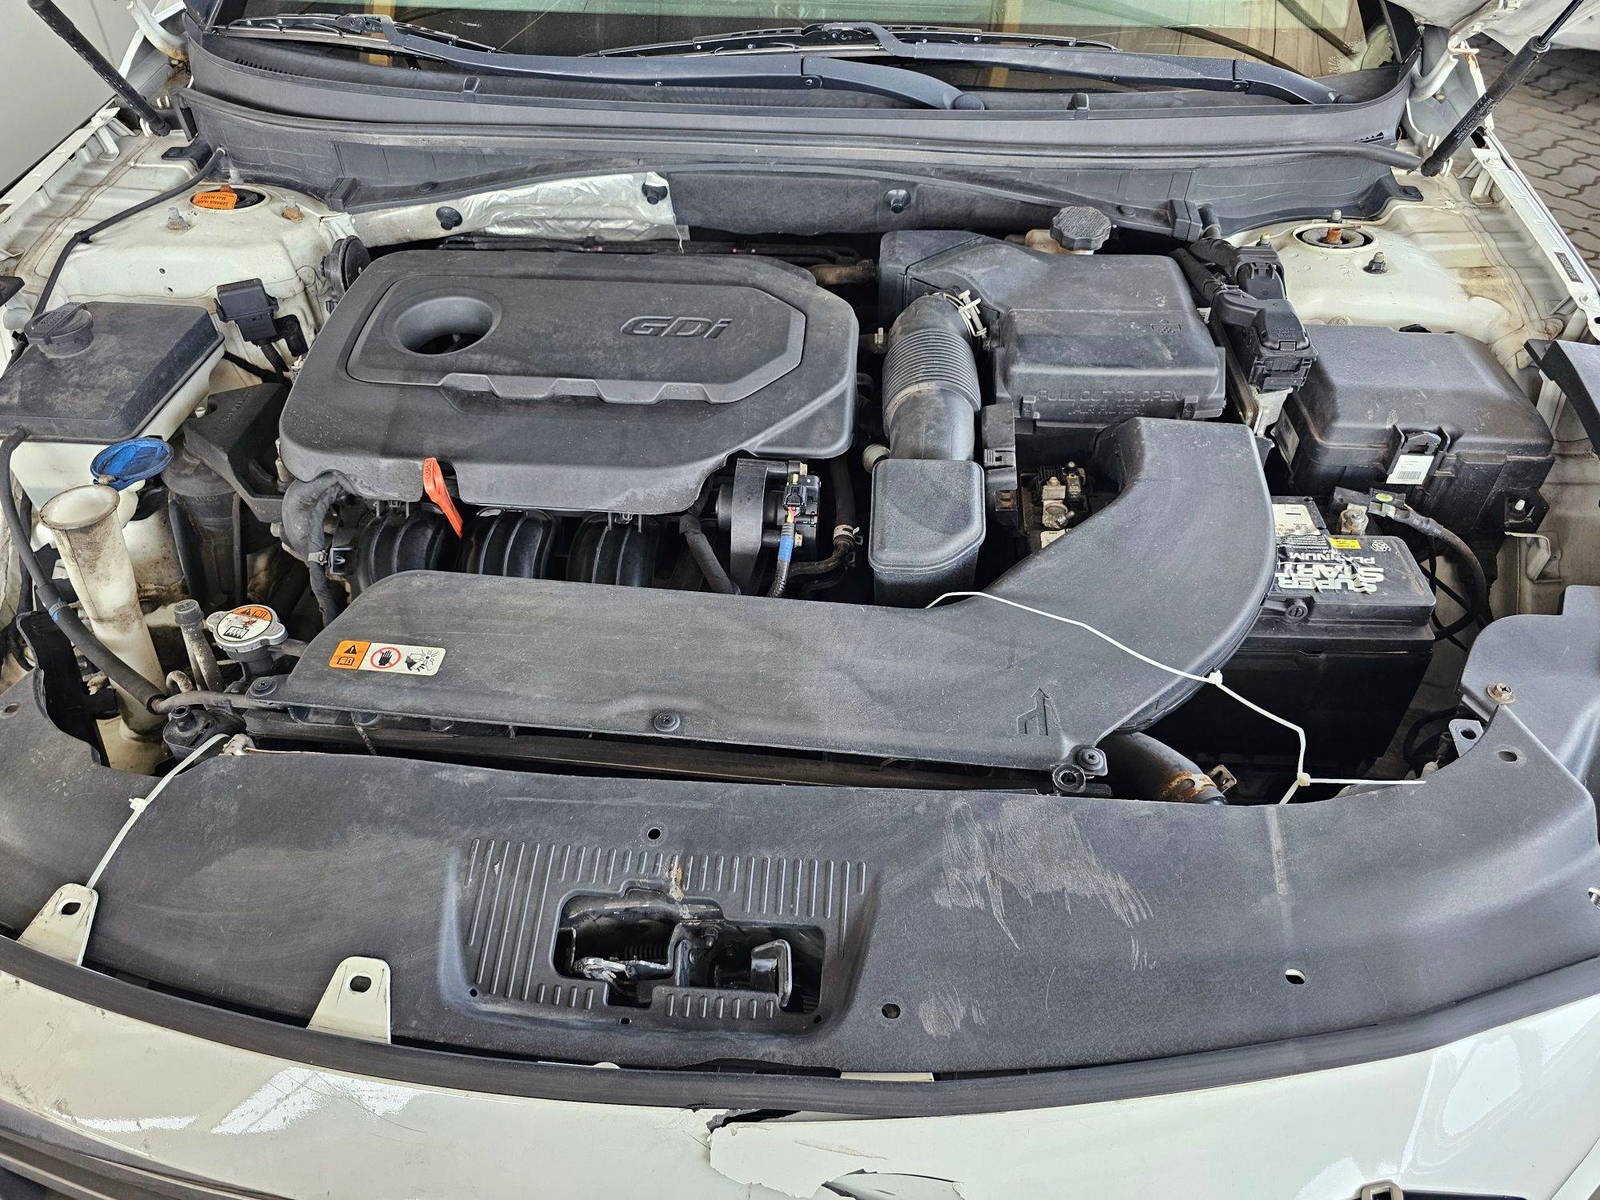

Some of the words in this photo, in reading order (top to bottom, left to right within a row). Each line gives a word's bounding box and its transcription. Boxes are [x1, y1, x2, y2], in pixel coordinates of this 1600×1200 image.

[1037, 390, 1075, 401] PULL
[1079, 390, 1112, 401] OUT
[1116, 390, 1135, 401] TO
[1139, 390, 1183, 401] OPEN
[1275, 563, 1385, 583] START
[1277, 575, 1377, 593] SUPER
